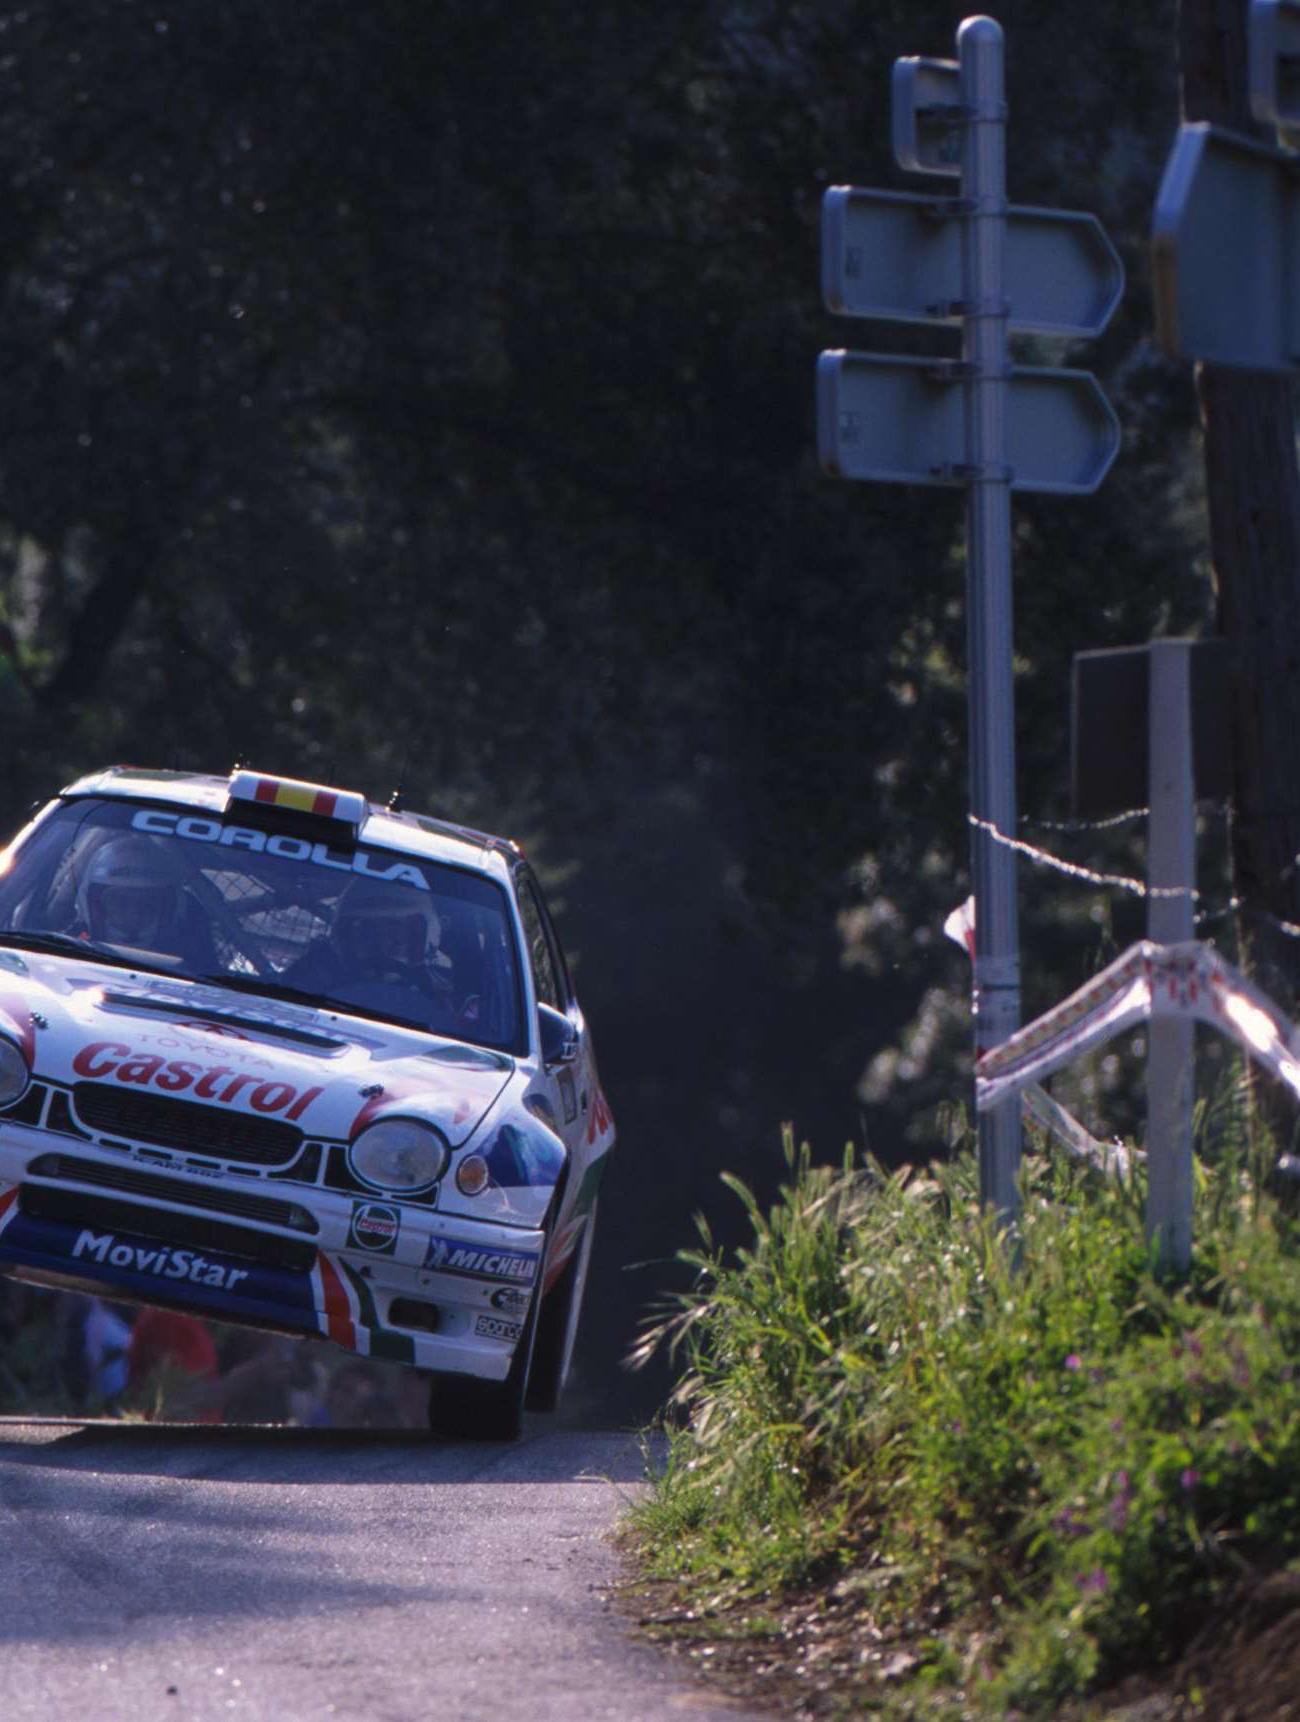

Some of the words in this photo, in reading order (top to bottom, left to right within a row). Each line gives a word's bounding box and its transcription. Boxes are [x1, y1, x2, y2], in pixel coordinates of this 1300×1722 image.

[131, 810, 431, 891] COROLLA
[72, 1041, 325, 1121] Castrol
[139, 1033, 276, 1070] TOYOTA
[70, 1228, 250, 1292] MoviStar
